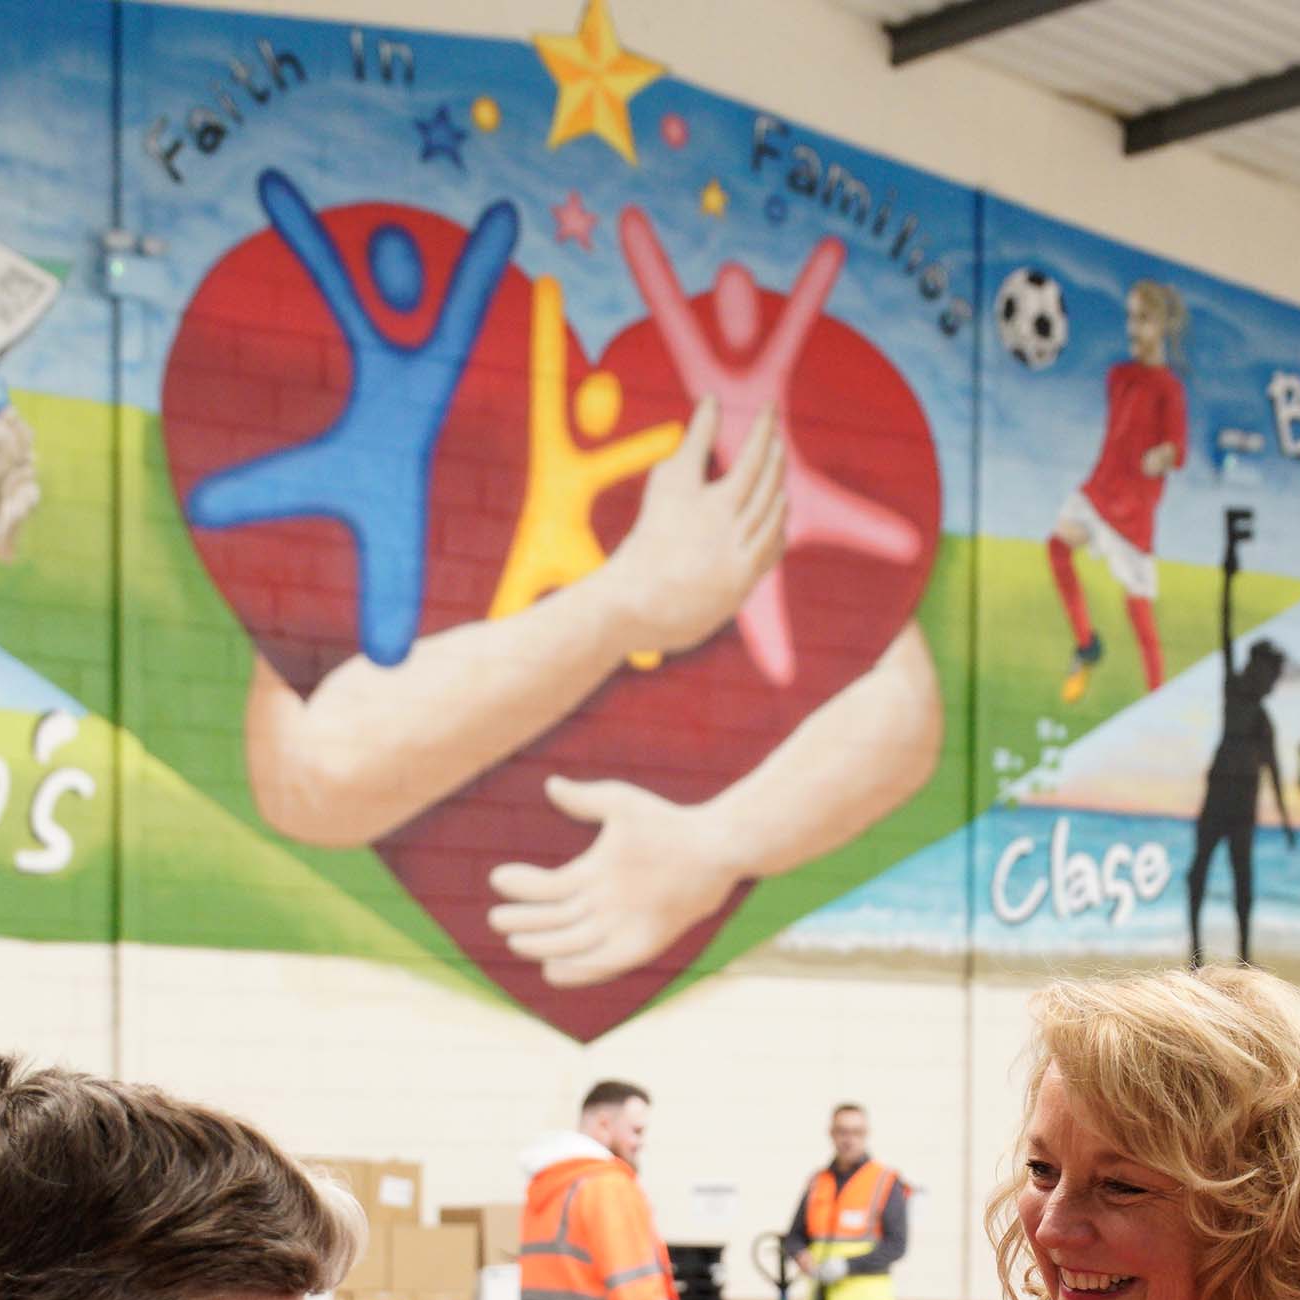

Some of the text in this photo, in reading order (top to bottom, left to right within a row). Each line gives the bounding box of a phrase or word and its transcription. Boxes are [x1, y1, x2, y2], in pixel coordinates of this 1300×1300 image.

[145, 37, 308, 185] Faith
[750, 113, 974, 339] Families
[990, 815, 1171, 927] Clase
